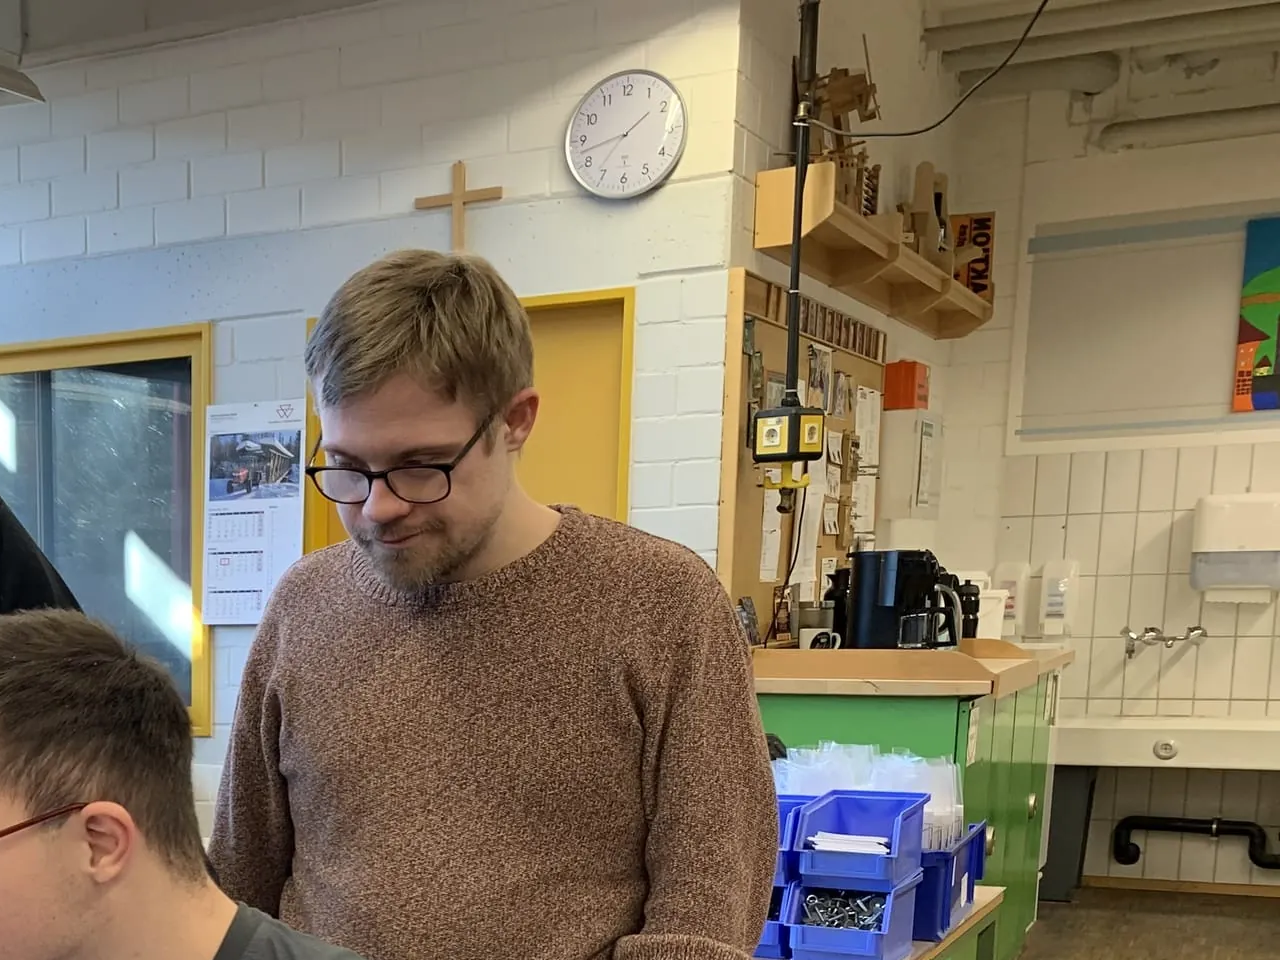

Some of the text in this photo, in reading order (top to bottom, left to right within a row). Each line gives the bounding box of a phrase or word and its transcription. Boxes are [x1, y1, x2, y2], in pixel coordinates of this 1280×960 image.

[622, 84, 634, 96] 12
[602, 94, 612, 106] 11
[660, 100, 668, 113] 2
[586, 113, 598, 126] 10
[580, 134, 587, 146] 9
[658, 146, 665, 156] 4
[584, 156, 592, 168] 8
[600, 169, 607, 181] 7
[641, 163, 649, 175] 5
[620, 172, 628, 184] 6
